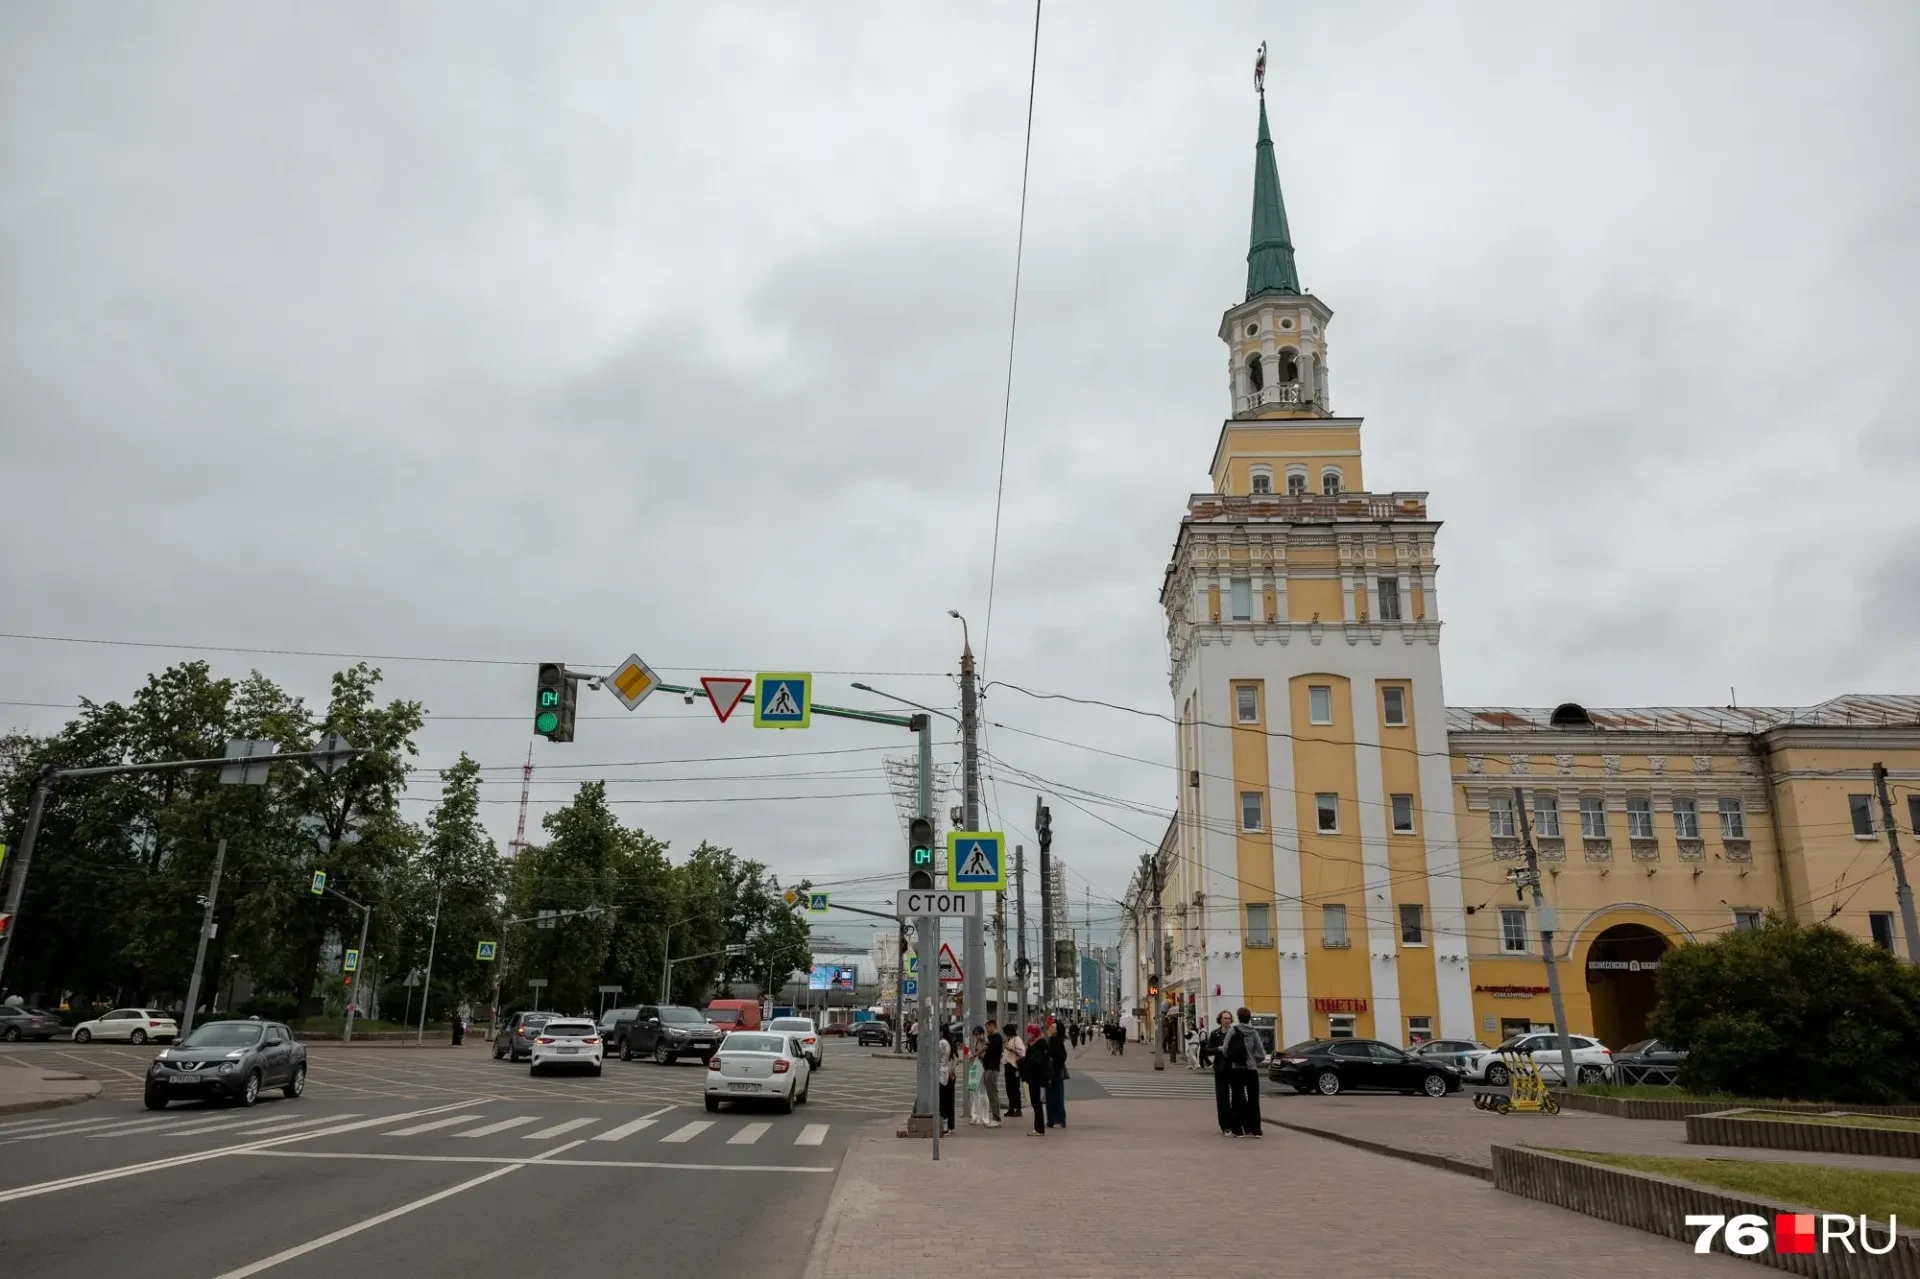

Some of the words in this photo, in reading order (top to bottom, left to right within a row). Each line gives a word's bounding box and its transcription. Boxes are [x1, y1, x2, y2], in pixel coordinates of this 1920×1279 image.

[542, 692, 558, 706] 04
[915, 849, 932, 865] 04
[908, 894, 966, 913] СТОП
[1314, 998, 1368, 1013] ЦВЕТЫ
